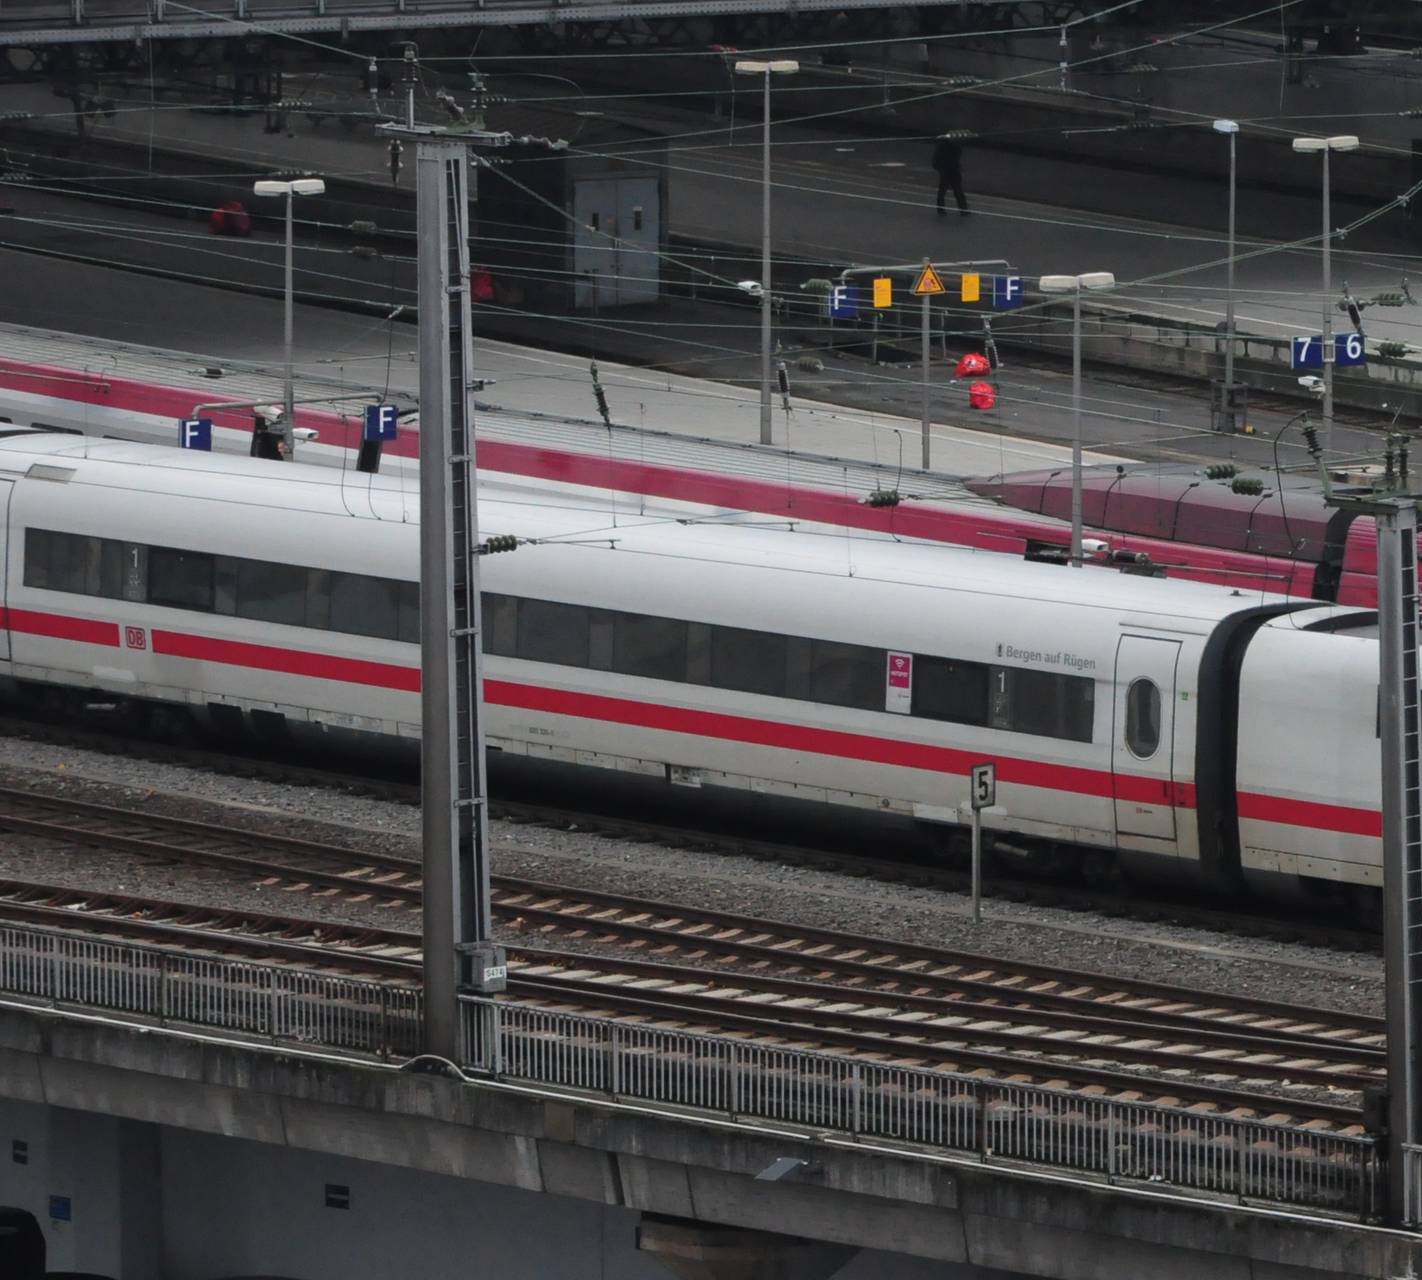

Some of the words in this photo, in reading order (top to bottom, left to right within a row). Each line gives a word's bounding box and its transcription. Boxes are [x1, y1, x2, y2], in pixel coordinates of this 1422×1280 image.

[834, 286, 847, 310] F
[1006, 276, 1019, 301] F
[1298, 337, 1312, 362] 7
[1346, 333, 1361, 359] 6
[378, 406, 393, 433] F
[185, 421, 199, 448] F
[132, 548, 138, 569] 1
[127, 628, 144, 647] DB
[1006, 645, 1041, 663] Bergen
[1044, 651, 1061, 665] auf
[1064, 653, 1096, 671] Rügen
[998, 671, 1005, 693] 1
[979, 770, 988, 801] 5
